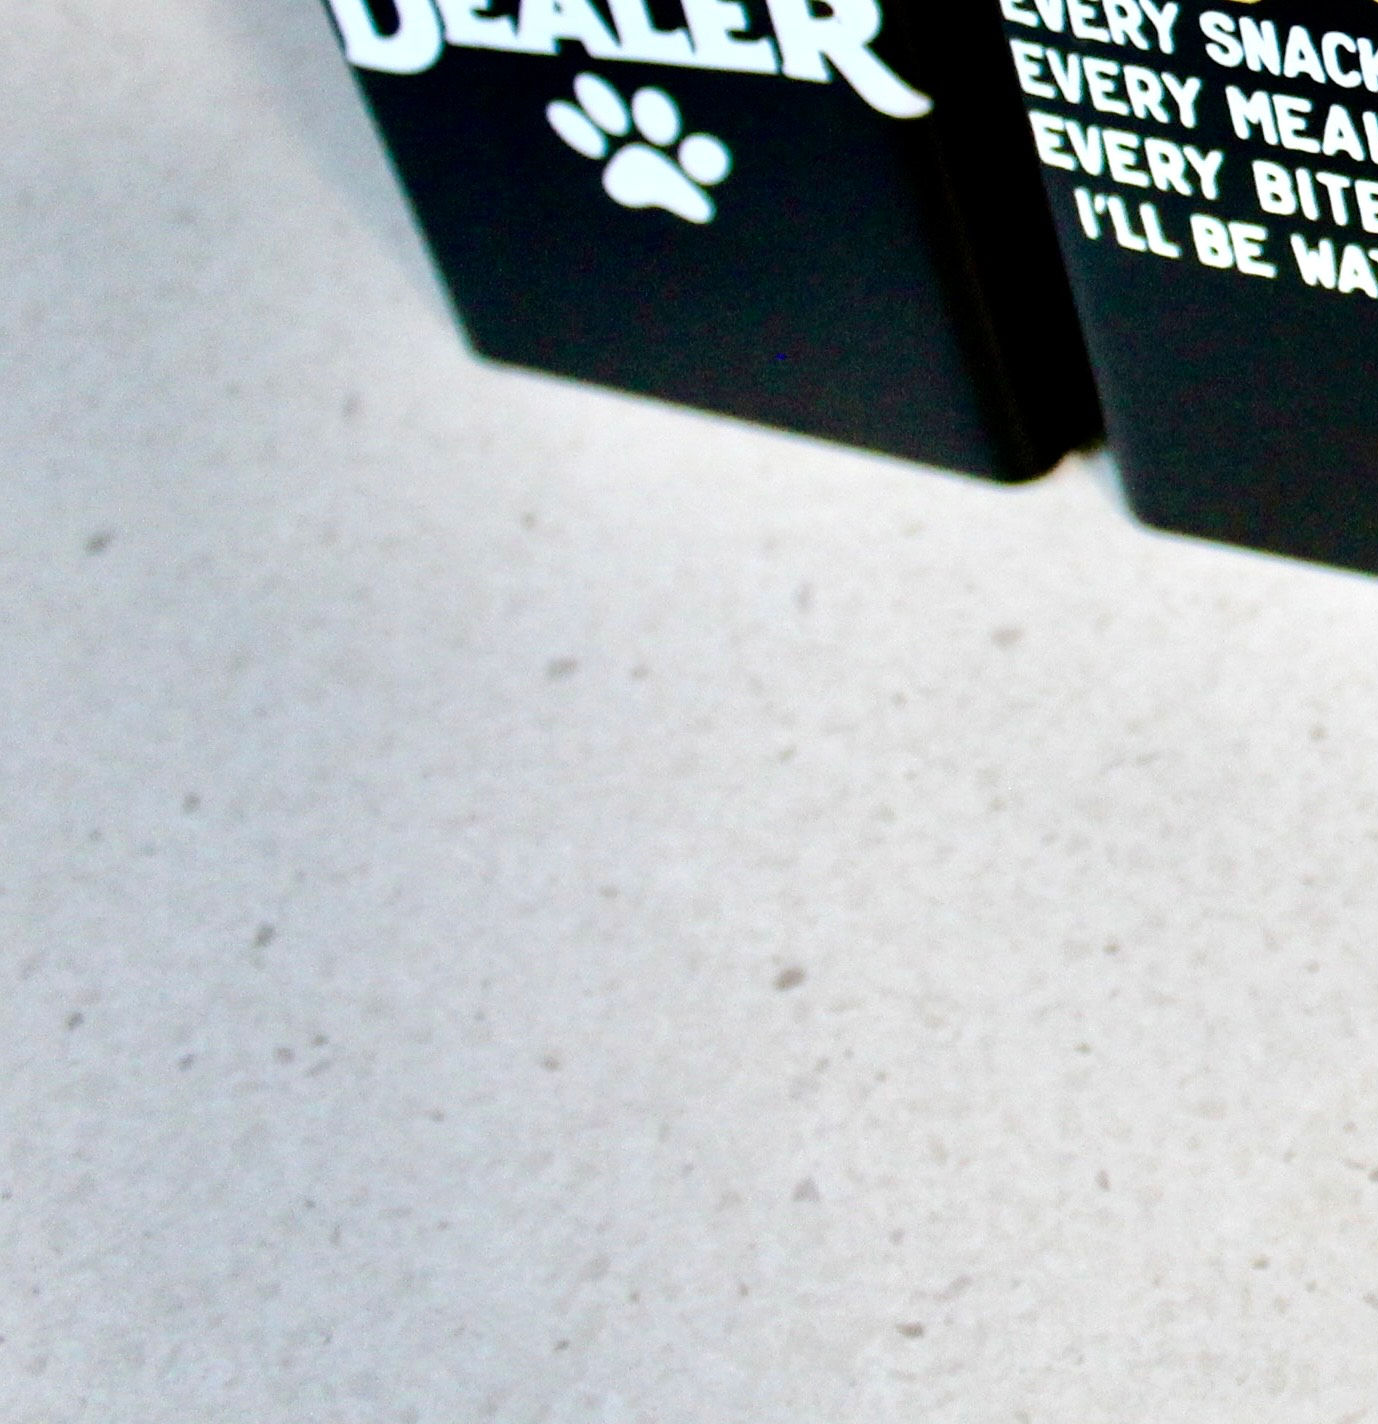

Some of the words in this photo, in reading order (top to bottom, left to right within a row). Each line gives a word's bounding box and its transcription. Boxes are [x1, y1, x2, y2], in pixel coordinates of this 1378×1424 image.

[1010, 38, 1201, 129] EVERY
[1028, 110, 1223, 200] EVERY
[1073, 187, 1180, 258] I'LL
[1190, 213, 1276, 279] BE
